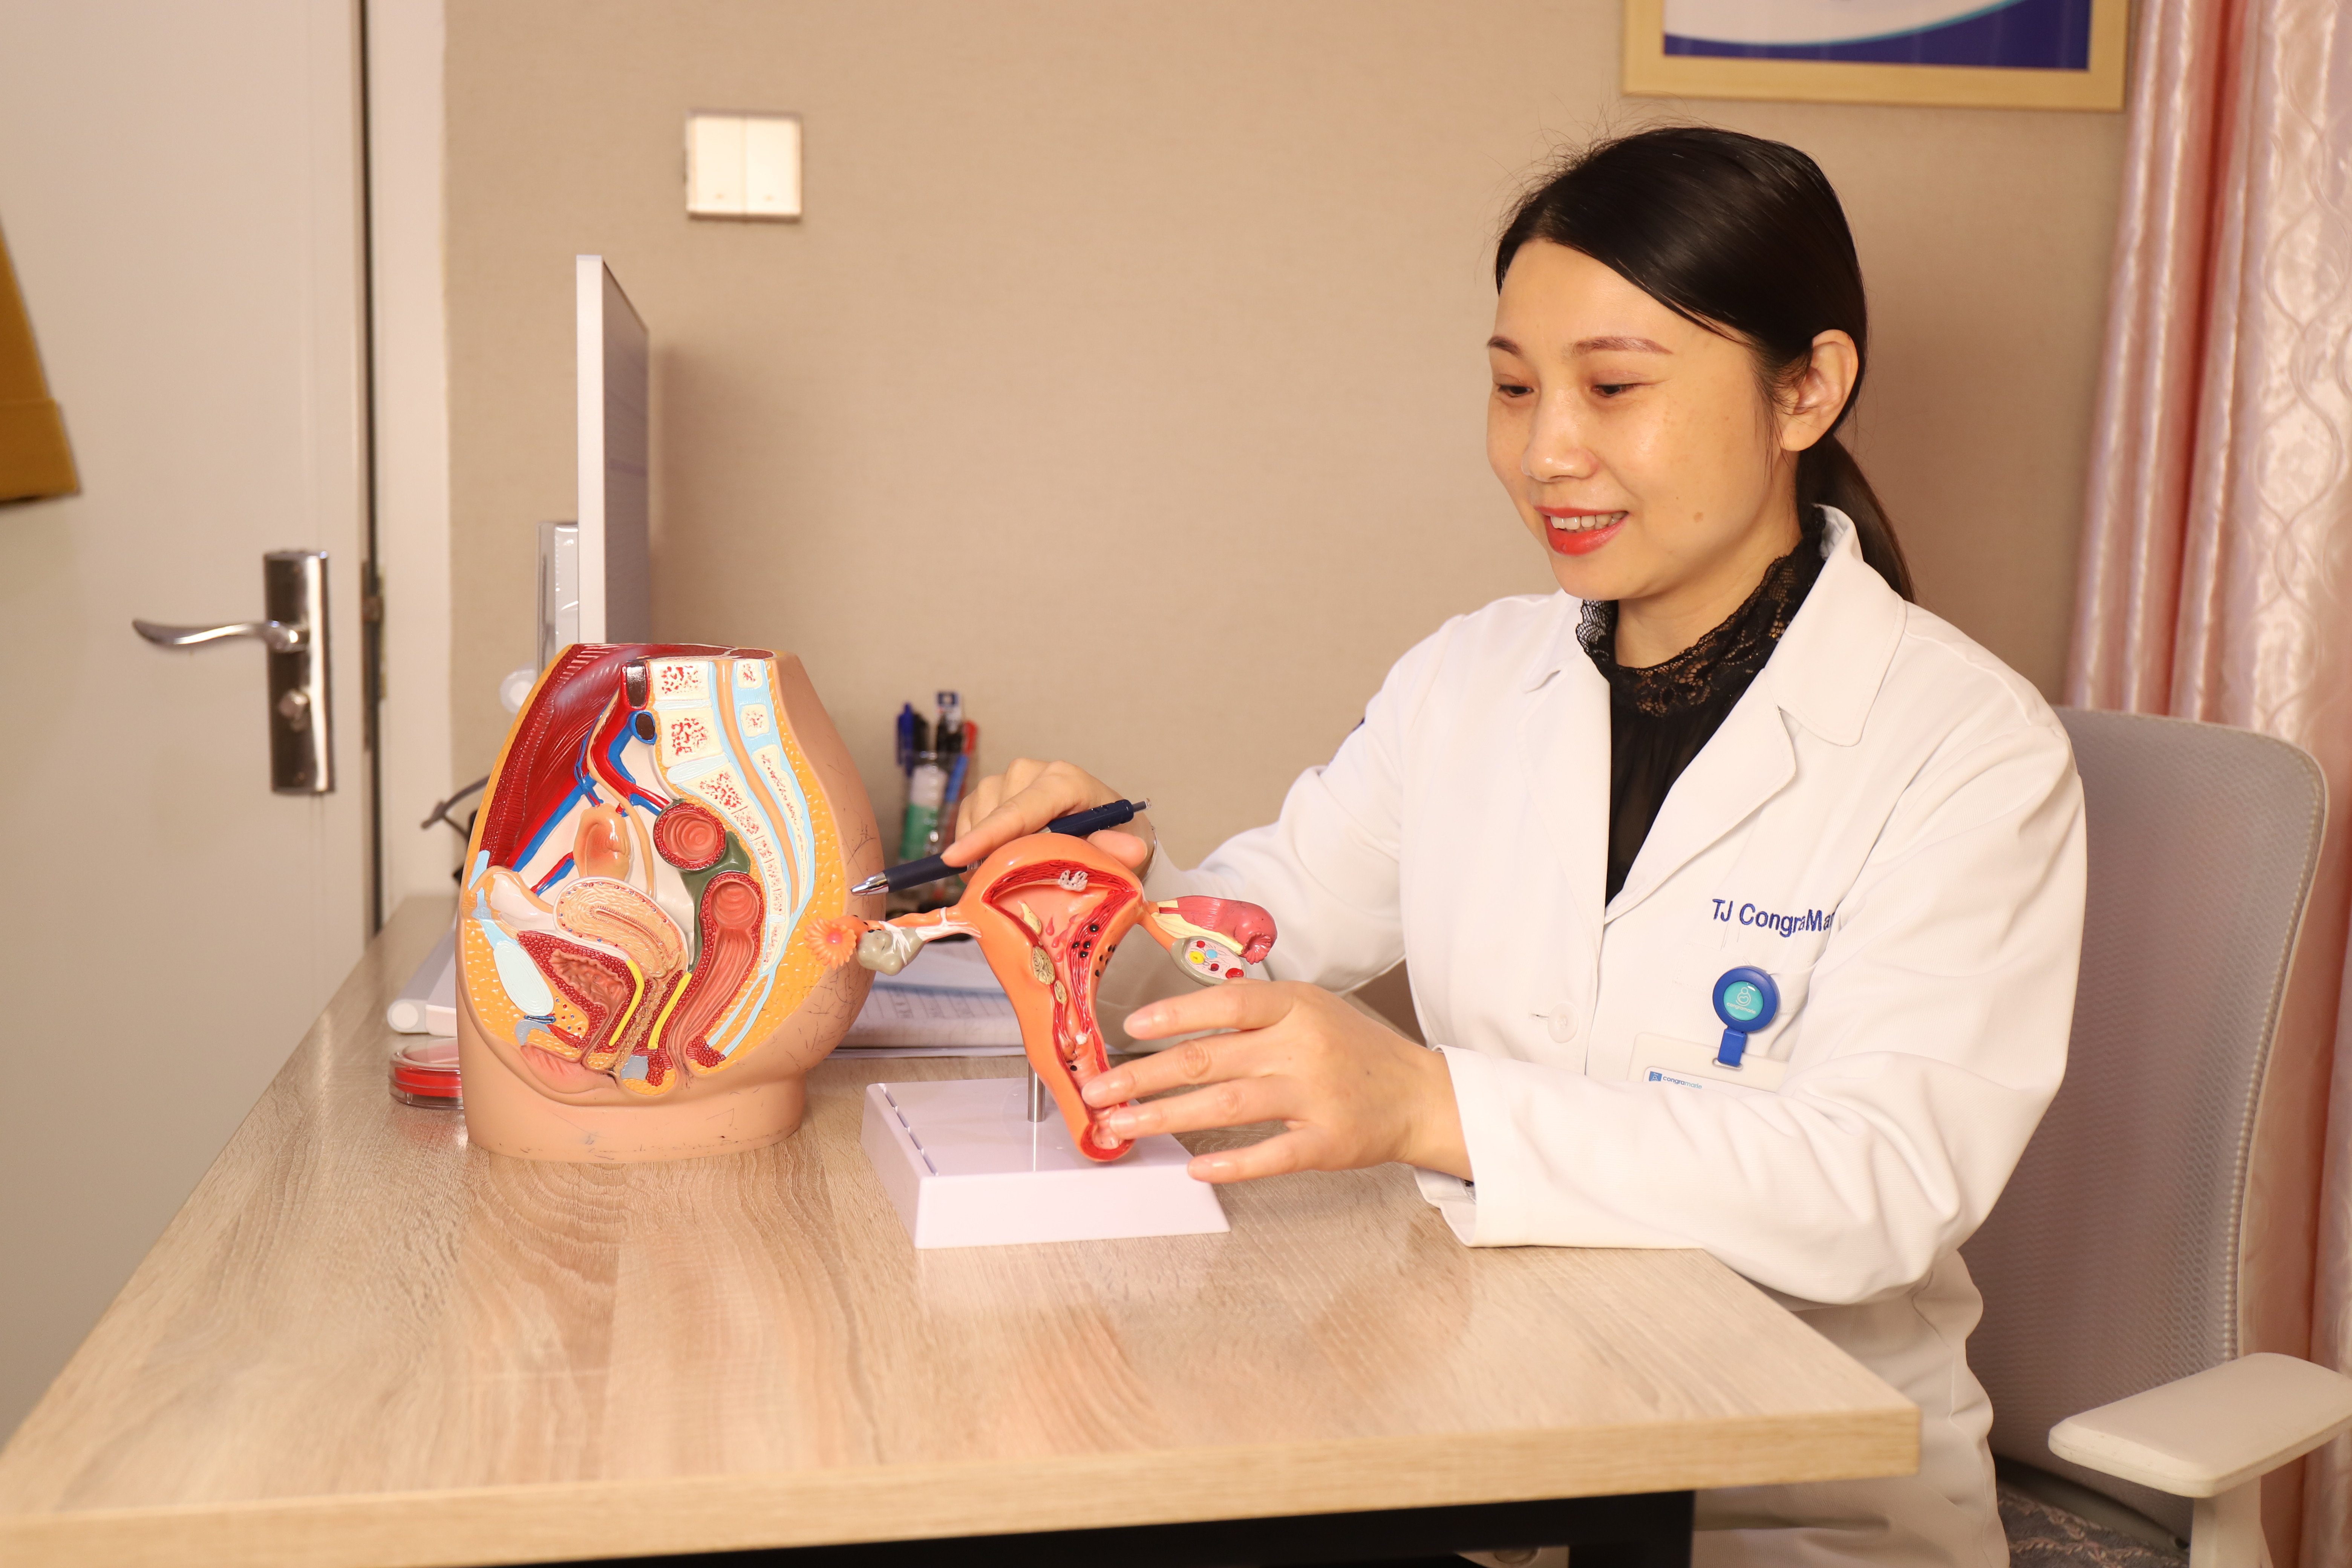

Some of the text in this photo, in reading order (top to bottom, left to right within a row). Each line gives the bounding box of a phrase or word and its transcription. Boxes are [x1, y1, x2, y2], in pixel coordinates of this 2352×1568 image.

[1712, 899, 1733, 922] TJ
[1727, 1003, 1756, 1014] congramarie
[1663, 1076, 1702, 1089] congramarie
